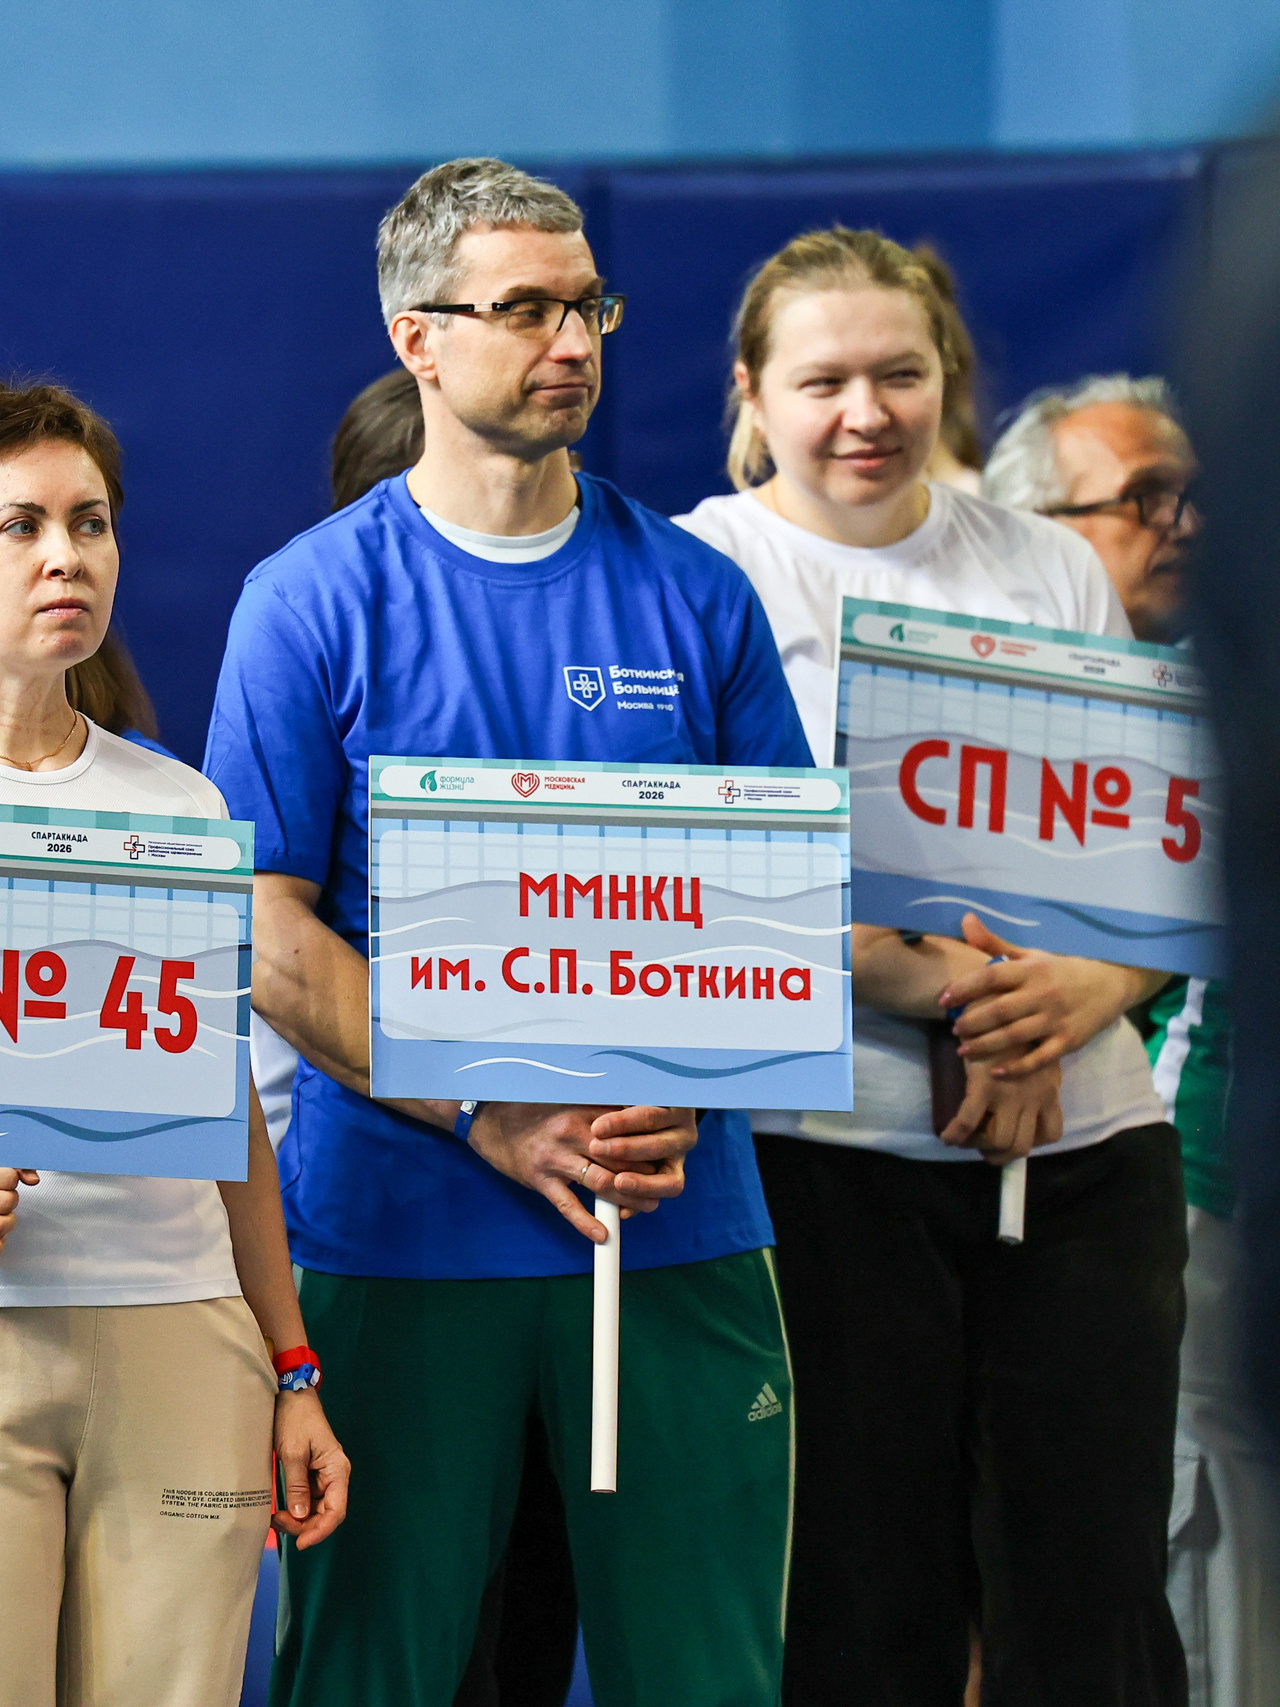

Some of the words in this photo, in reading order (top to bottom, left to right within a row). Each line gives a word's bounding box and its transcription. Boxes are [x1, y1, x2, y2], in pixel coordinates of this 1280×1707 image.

[612, 681, 680, 697] Больница
[617, 700, 655, 710] Москва
[622, 780, 681, 789] СПАРТАКИАДА
[638, 791, 665, 800] 2026
[899, 738, 1008, 833] СП
[1039, 757, 1132, 847] №
[1162, 777, 1202, 862] 5
[31, 831, 89, 842] СПАРТАКИАДА
[47, 843, 73, 853] 2026
[519, 872, 703, 929] ММНКЦ
[411, 956, 486, 992] им.
[502, 946, 593, 995] С.П.
[610, 950, 812, 1001] Боткина
[100, 955, 198, 1054] 45
[159, 1510, 185, 1518] ORGANIC
